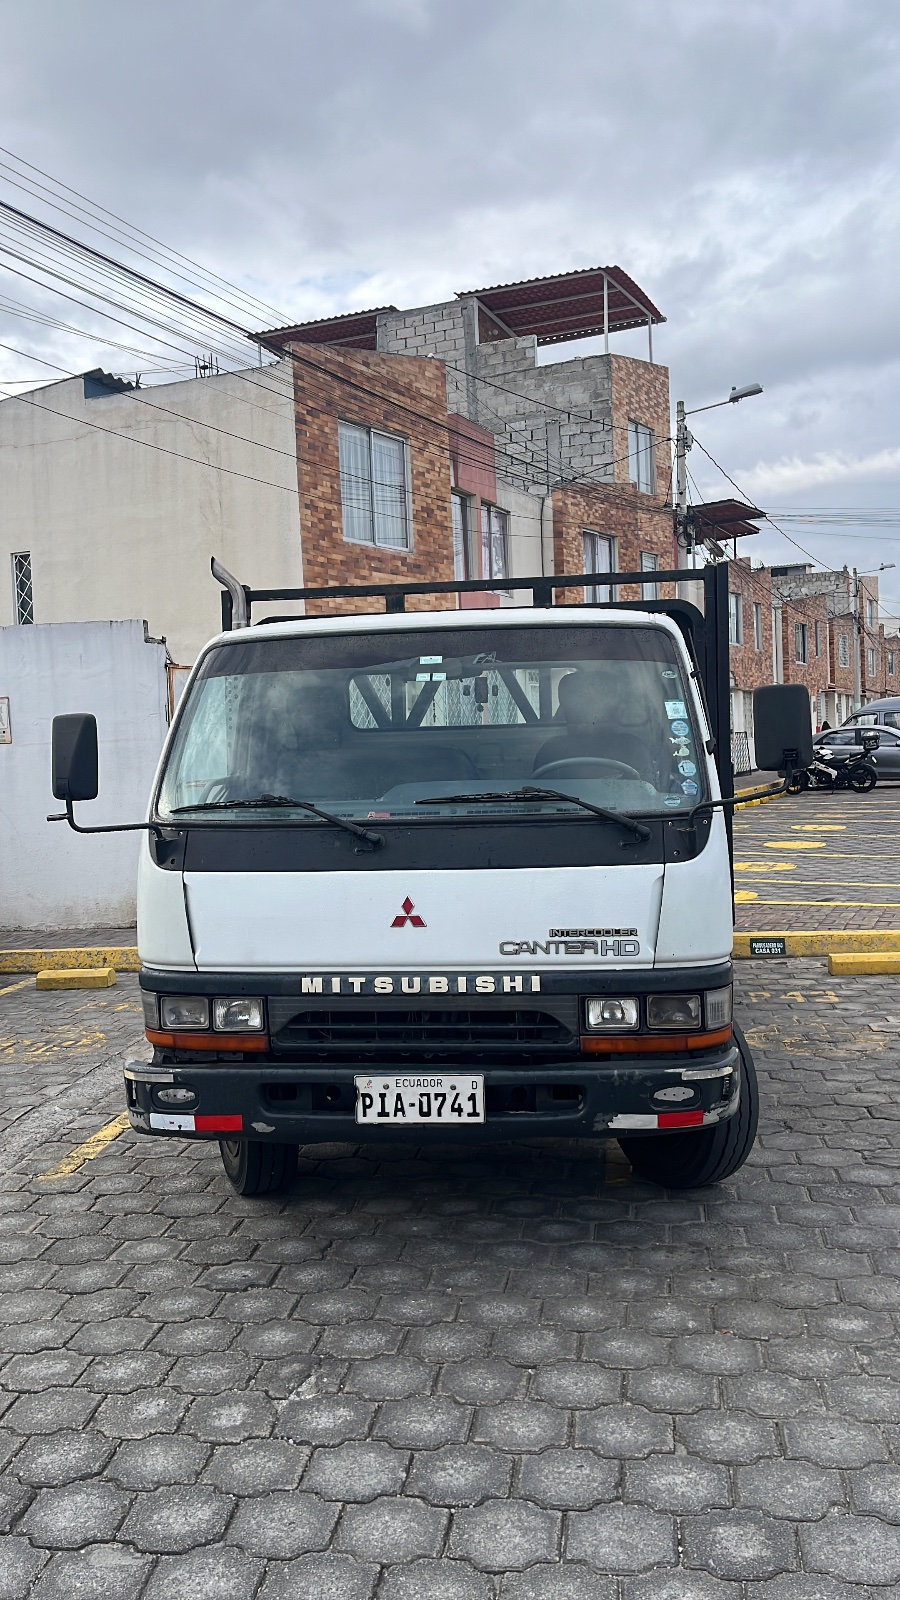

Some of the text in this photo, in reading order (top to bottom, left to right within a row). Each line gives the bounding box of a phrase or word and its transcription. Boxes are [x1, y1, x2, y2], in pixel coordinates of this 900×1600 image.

[549, 928, 638, 937] INTERCOOLER
[499, 940, 639, 956] CANTER HD
[301, 976, 540, 993] MITSUBISHI
[395, 1079, 478, 1090] ECUADOR D
[361, 1092, 480, 1117] PIA-0741
